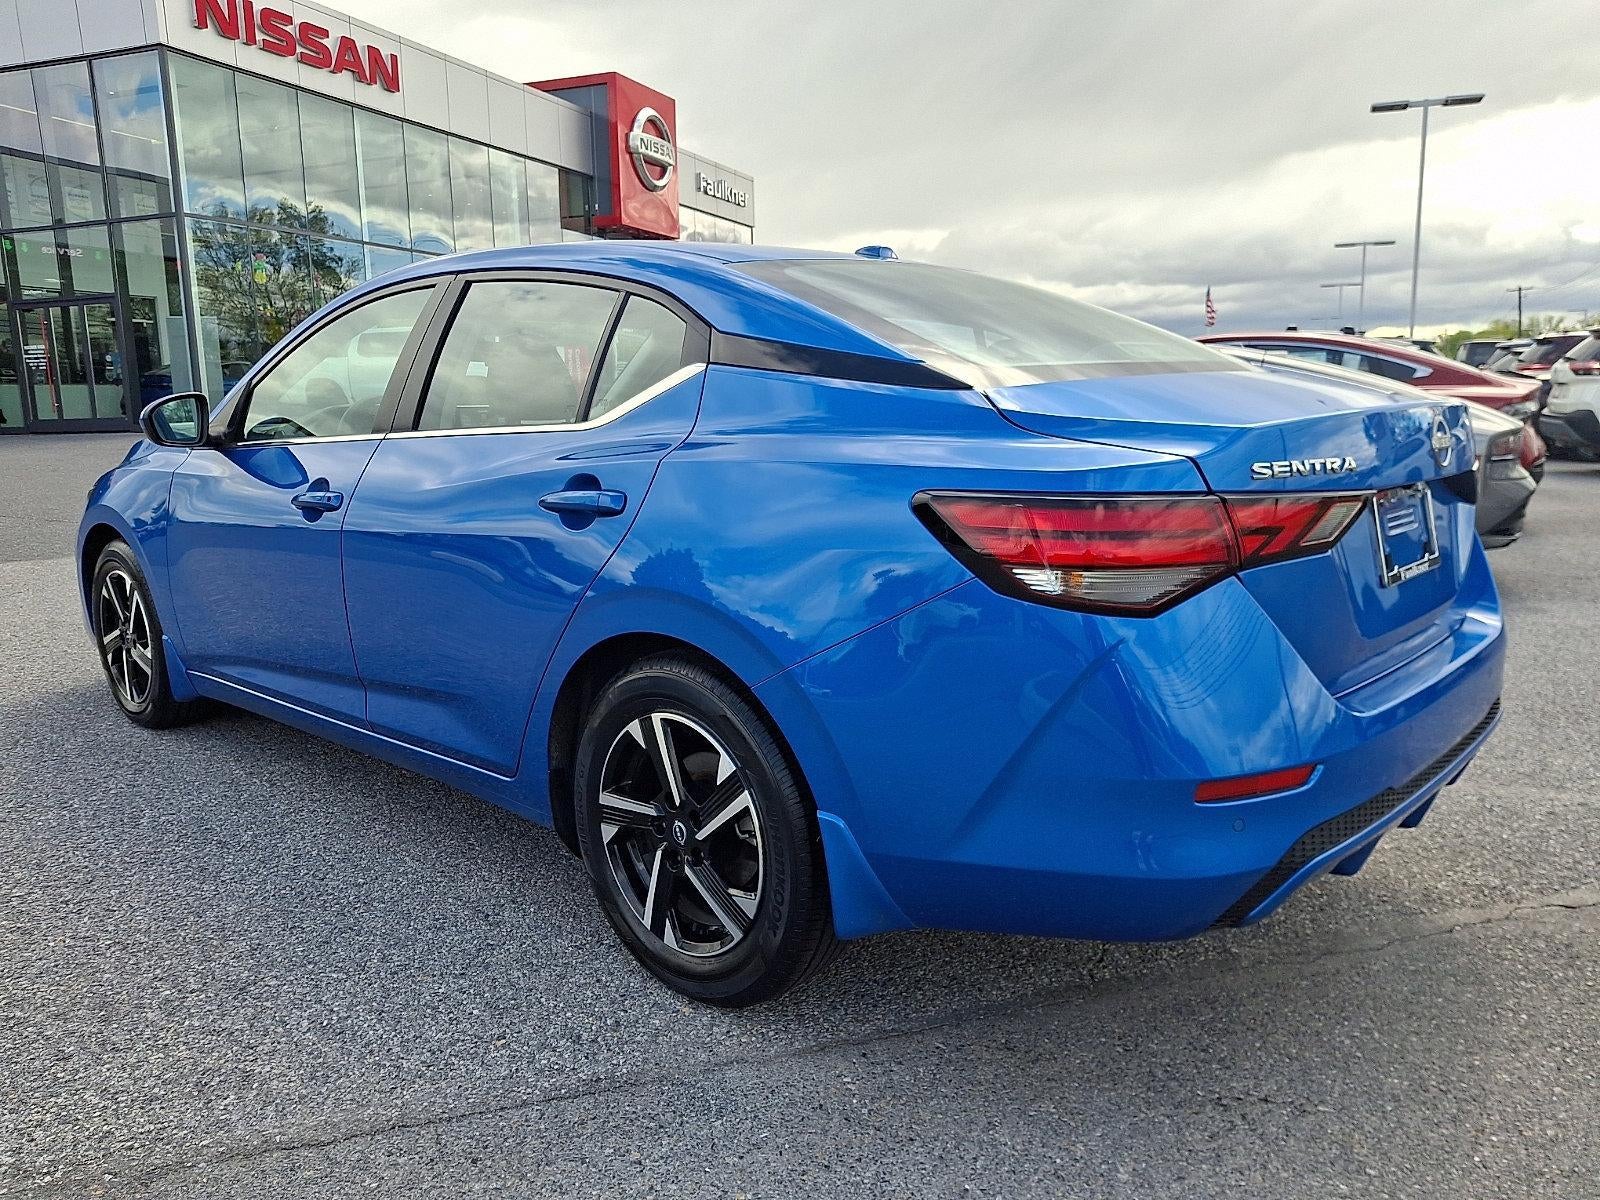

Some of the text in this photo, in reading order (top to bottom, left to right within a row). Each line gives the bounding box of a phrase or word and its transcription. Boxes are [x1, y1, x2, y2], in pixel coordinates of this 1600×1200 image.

[194, 0, 400, 93] NISSAN
[699, 172, 750, 207] Faulkner
[1251, 457, 1357, 480] SENTRA
